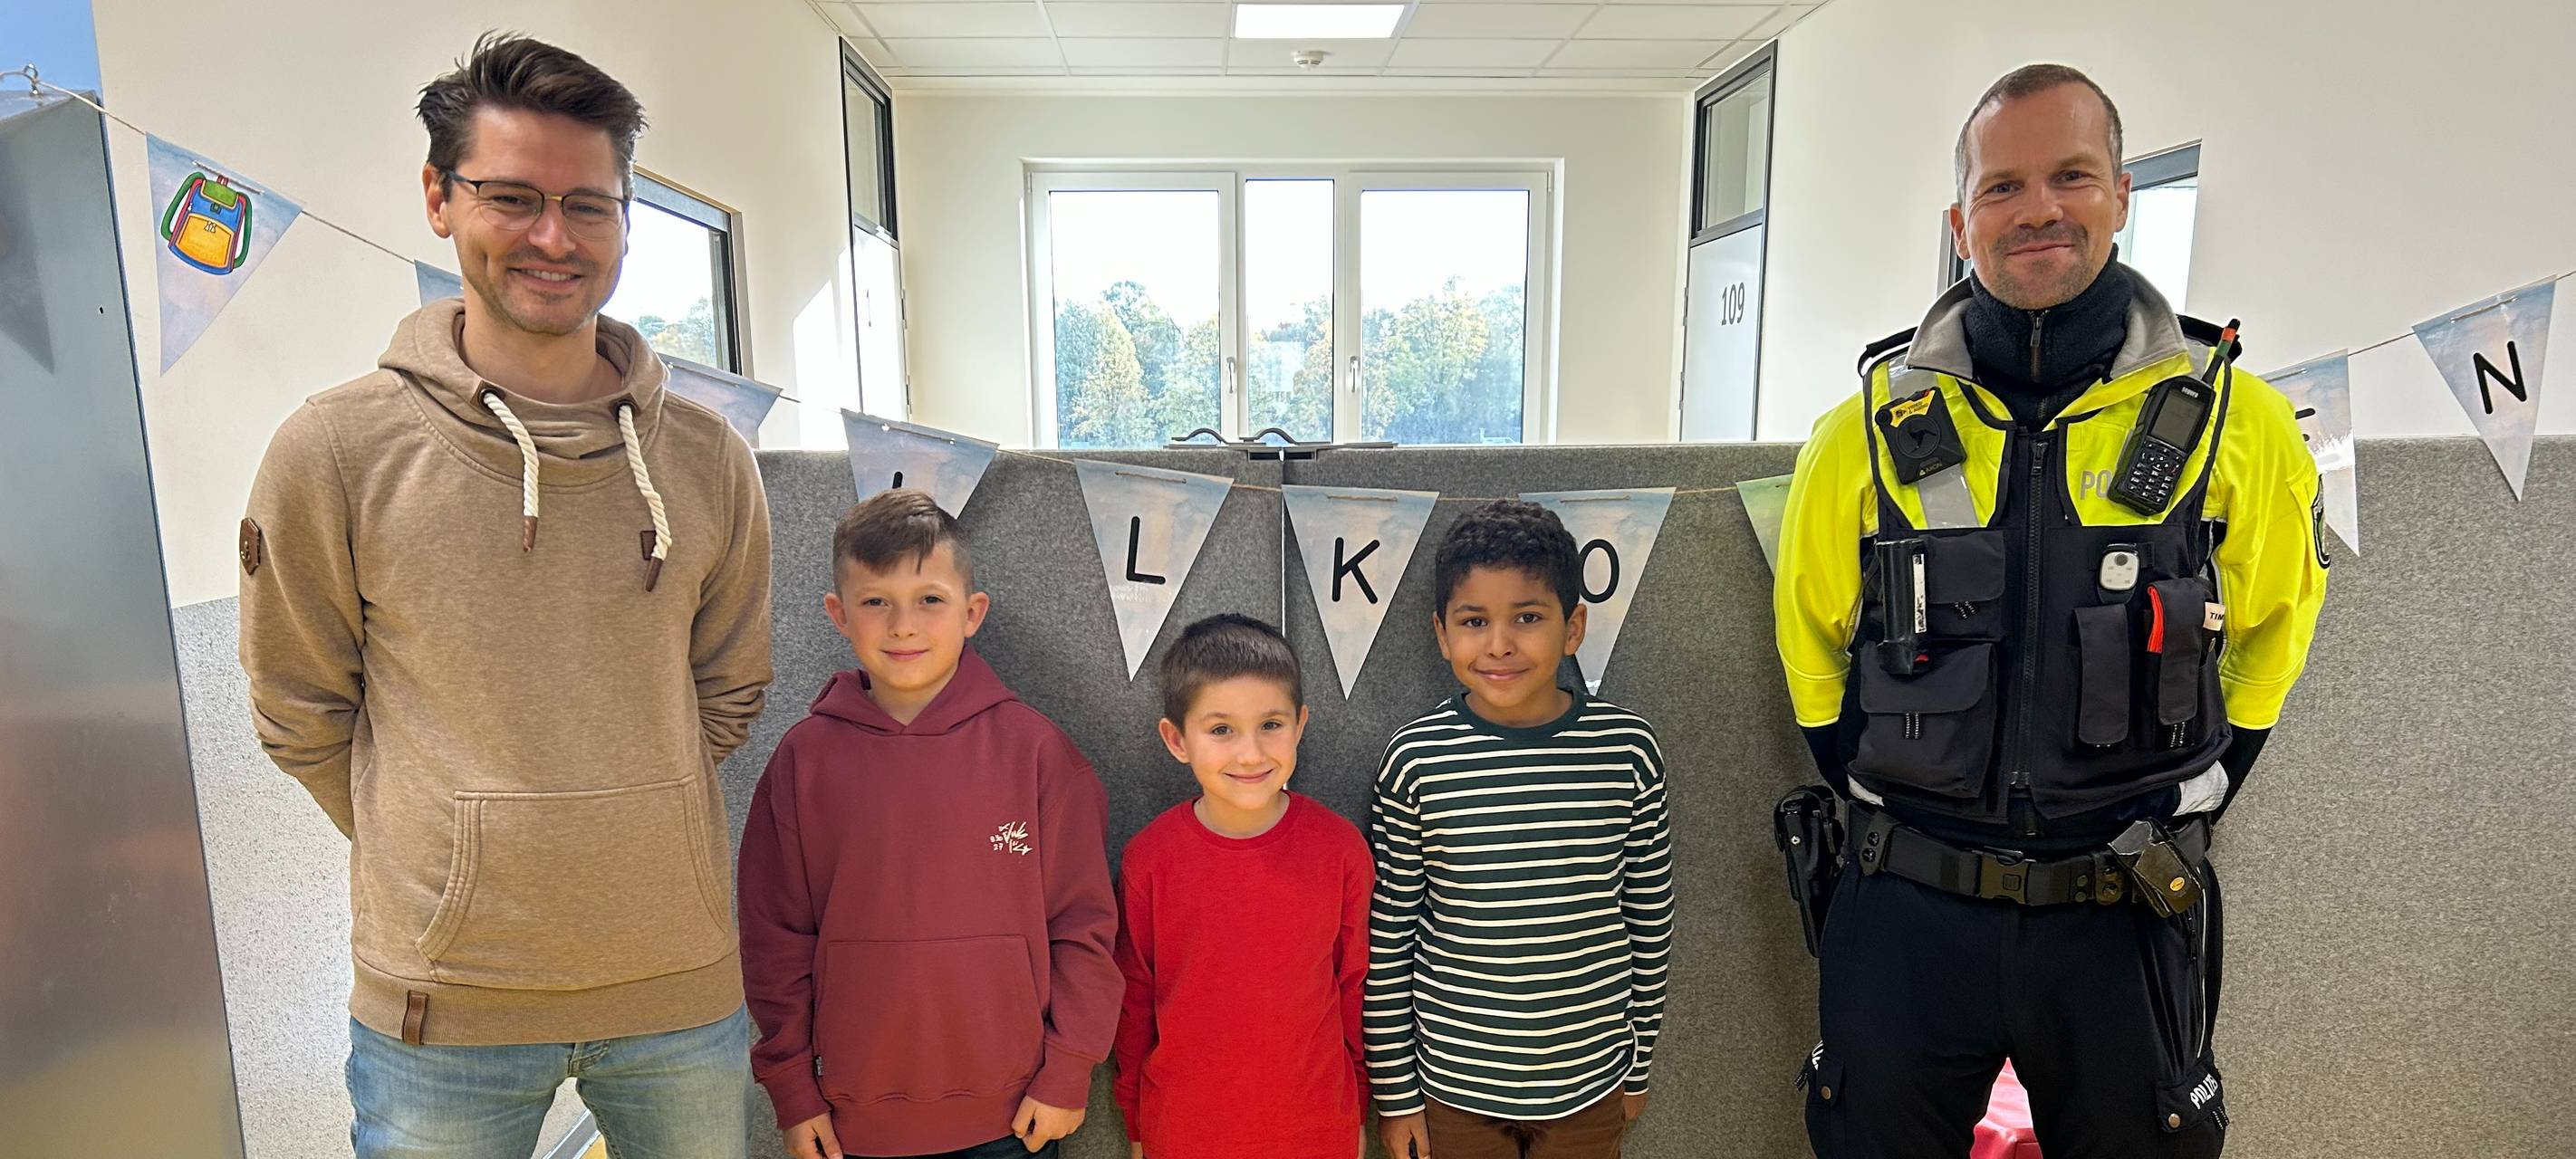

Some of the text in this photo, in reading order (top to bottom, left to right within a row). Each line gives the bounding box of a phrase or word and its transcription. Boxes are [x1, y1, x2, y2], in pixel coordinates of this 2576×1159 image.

[1721, 282, 1745, 326] 109
[2473, 340, 2527, 415] N
[2081, 469, 2113, 501] PO
[1126, 515, 1167, 585] L
[1331, 537, 1380, 605] K
[1579, 539, 1620, 604] O
